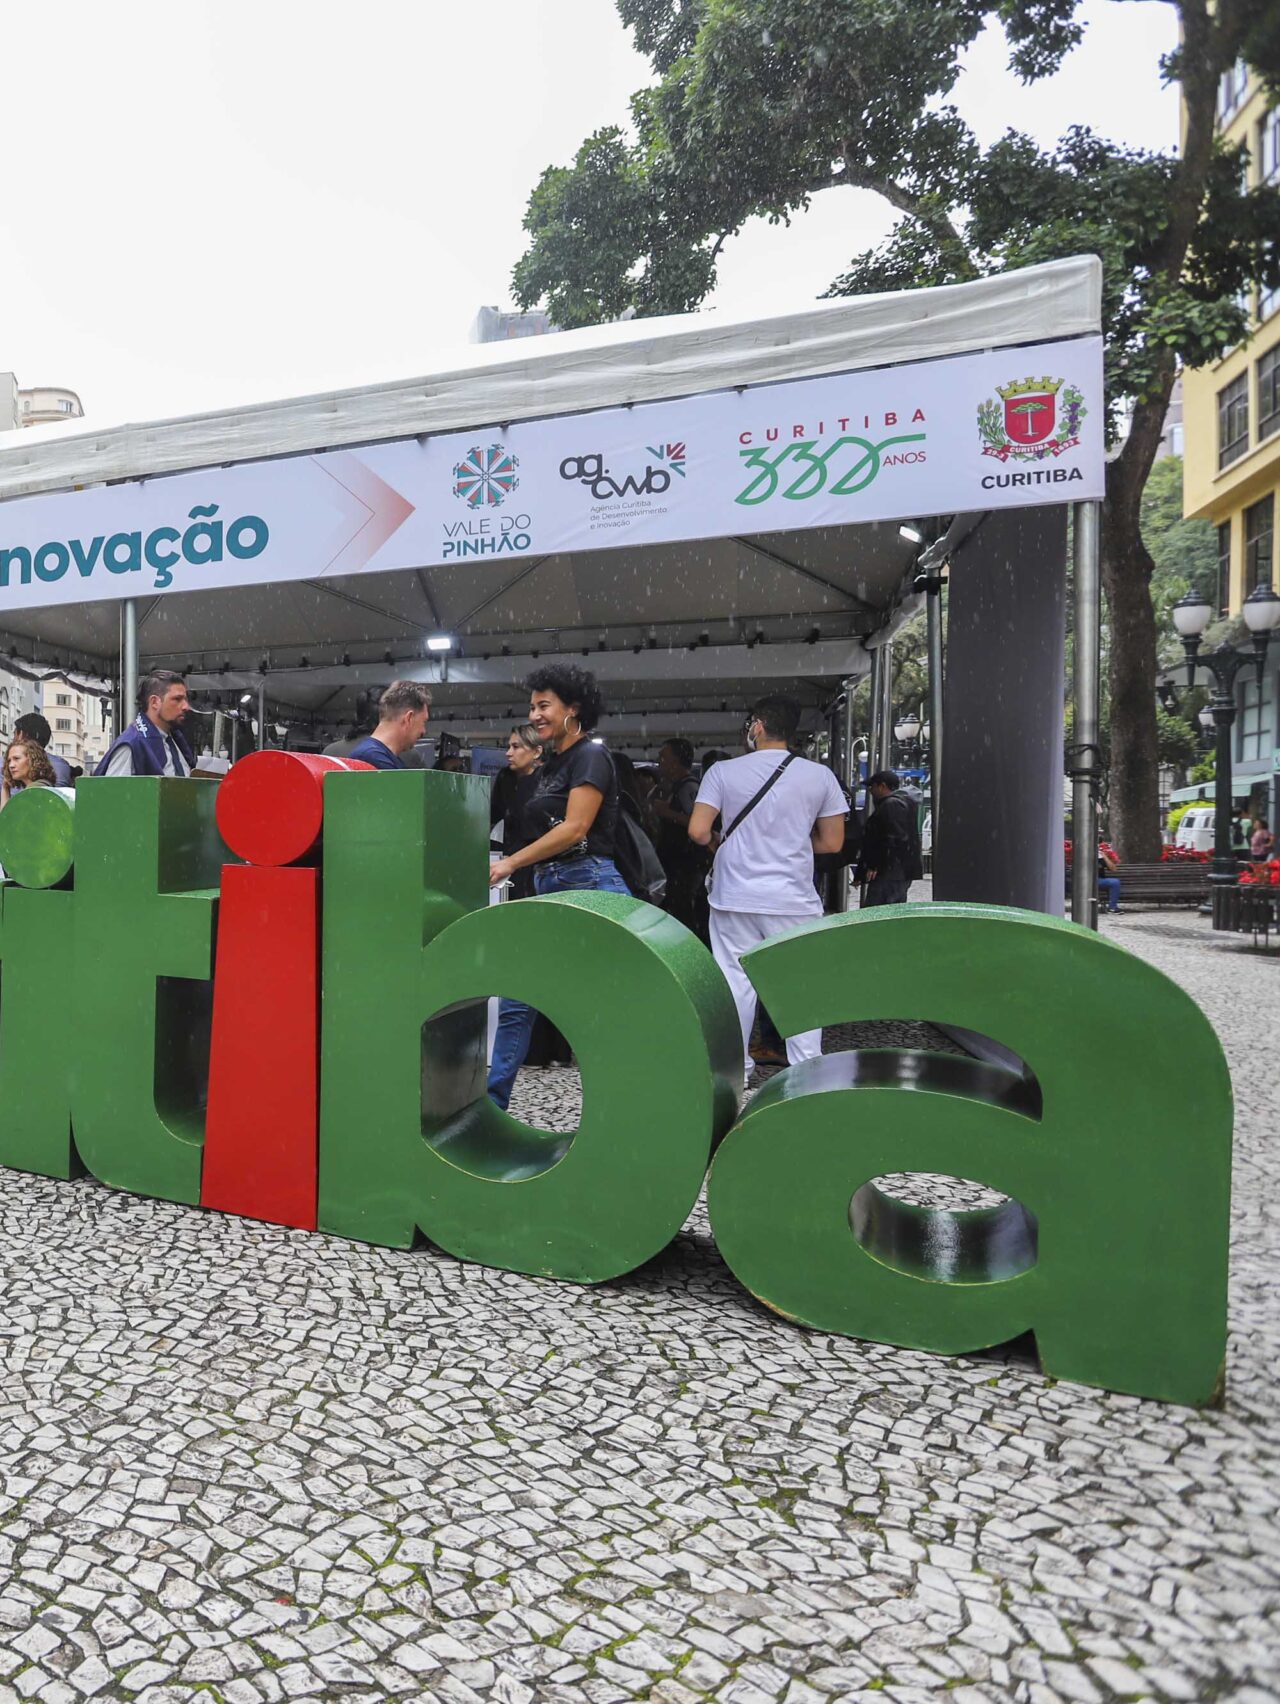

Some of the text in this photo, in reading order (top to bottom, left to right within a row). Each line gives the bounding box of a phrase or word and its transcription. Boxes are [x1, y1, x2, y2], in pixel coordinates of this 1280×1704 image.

[739, 408, 926, 445] CURITIBA
[1009, 443, 1050, 453] CURITIBA
[882, 451, 927, 467] ANOS
[981, 467, 1083, 490] CURITIBA
[601, 507, 668, 520] Desenvolvimento
[621, 500, 652, 509] Curitiba
[443, 513, 531, 537] VALE DO
[443, 532, 531, 558] PINHÃO
